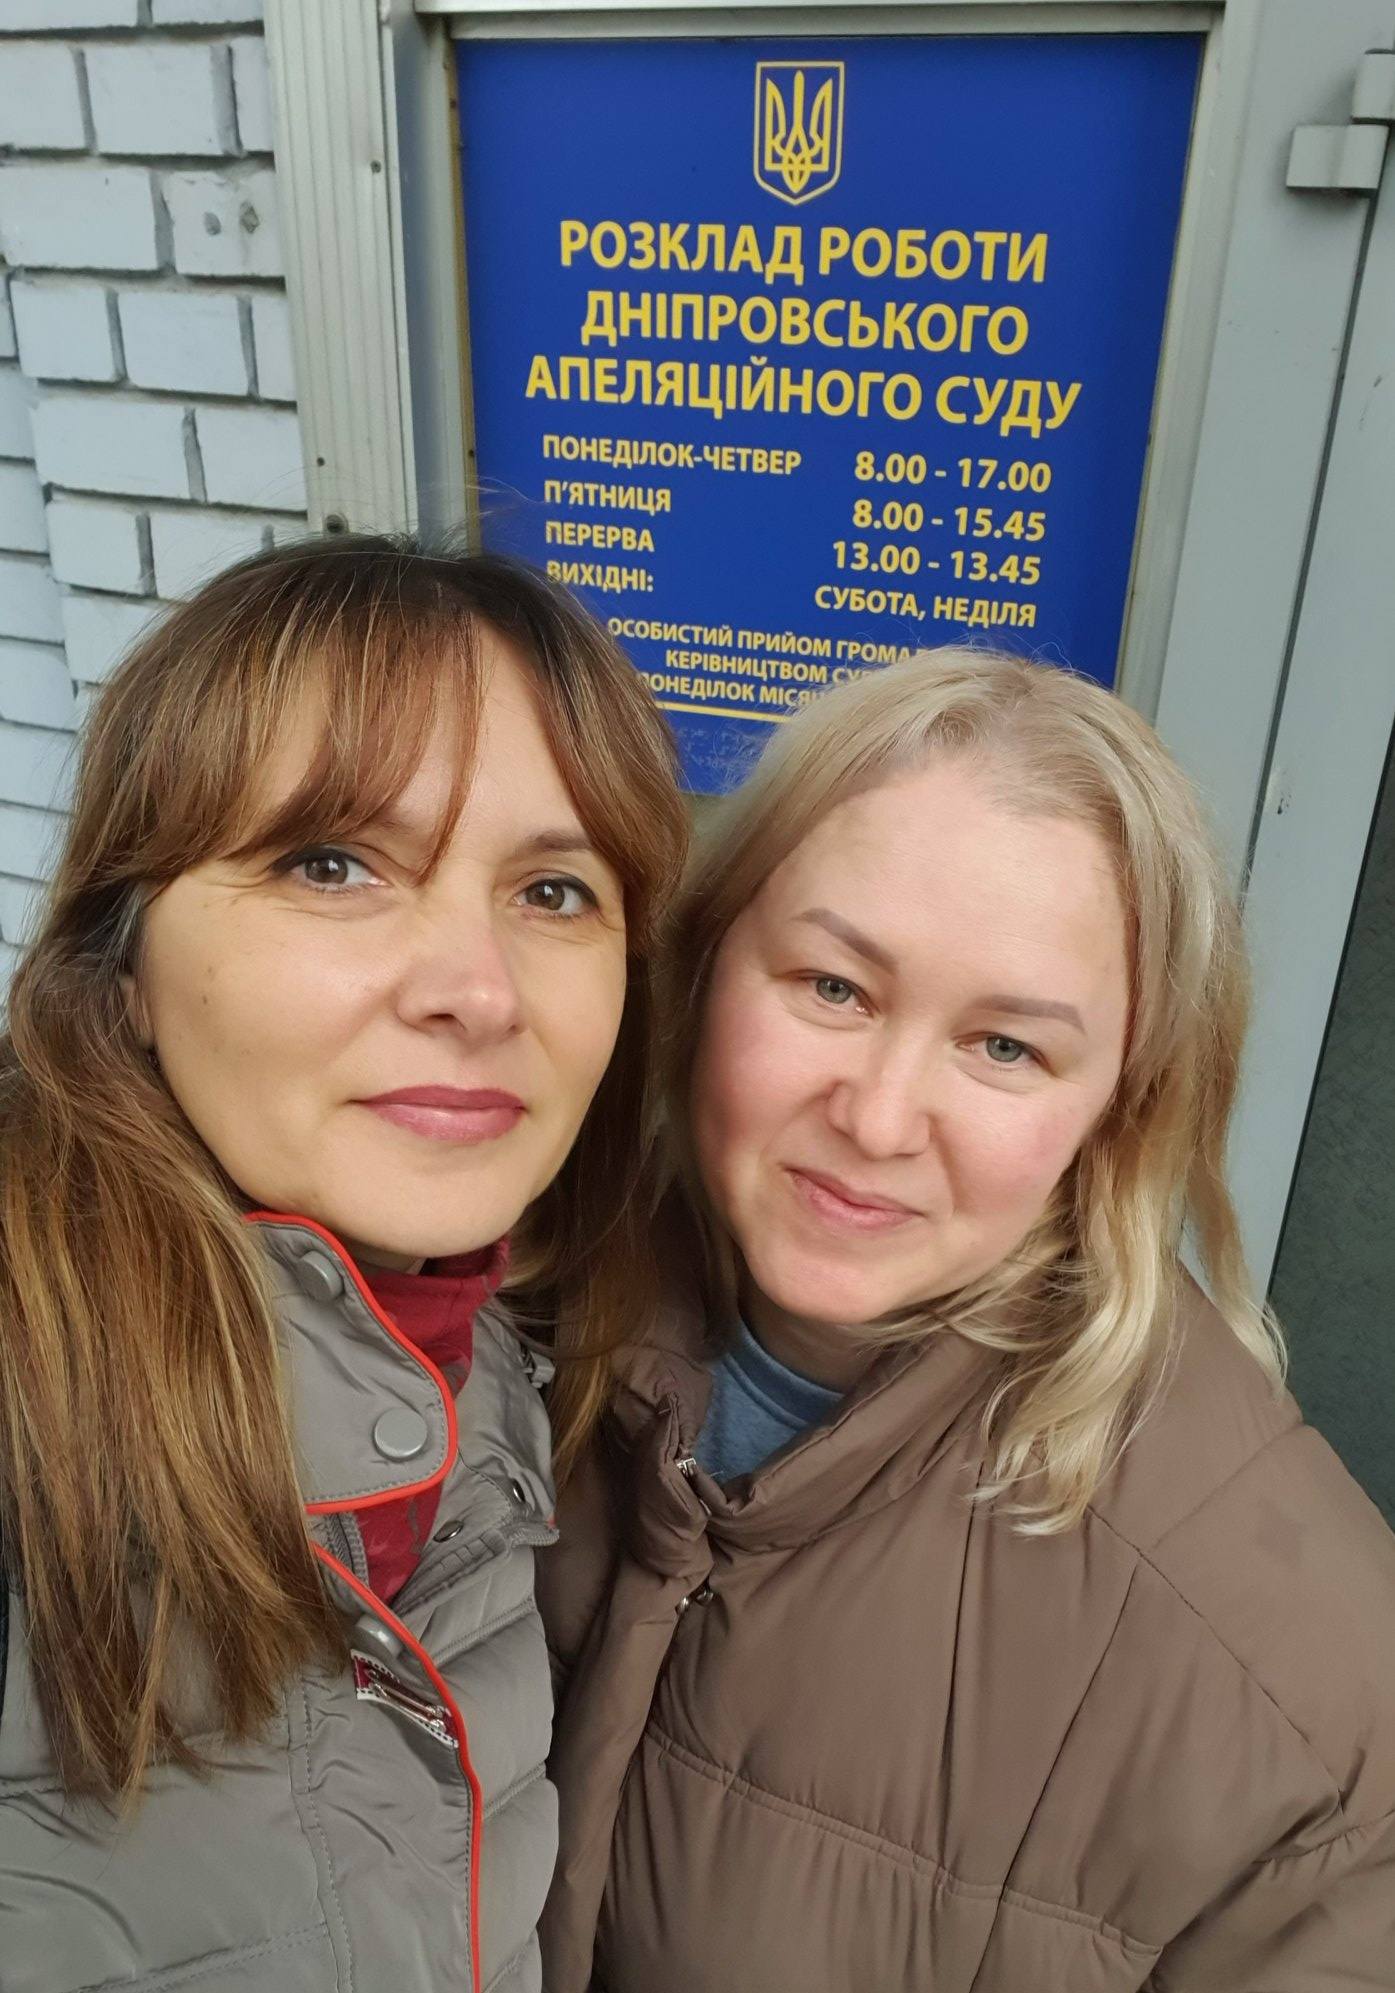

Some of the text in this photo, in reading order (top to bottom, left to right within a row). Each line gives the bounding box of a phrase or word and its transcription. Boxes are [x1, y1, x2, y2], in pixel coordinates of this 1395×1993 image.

[560, 220, 1048, 286] РОЗКЛАД РОБОТИ
[581, 290, 1030, 355] ДНІПРОВСЬКОГО
[525, 354, 1083, 439] АПЕЛЯЦІЙНОГО СУДУ
[542, 434, 802, 475] ПОНЕДІЛОК-ЧЕТВЕР
[854, 450, 928, 485] 8.00
[957, 457, 1052, 493] 17.00
[544, 479, 1046, 542] П’ЯТНИЦЯ 8.00 - 15.45
[545, 520, 1041, 586] ПЕРЕРВА 13.00 - 13.45
[546, 559, 1037, 629] ВИХІДНІ: СУБОТА, НЕДІЛЯ
[607, 617, 929, 665] ОСОБИСТИЙ ПРИЙОМ ГРОМА
[665, 649, 828, 684] КЕРІВНИЦТВОМ
